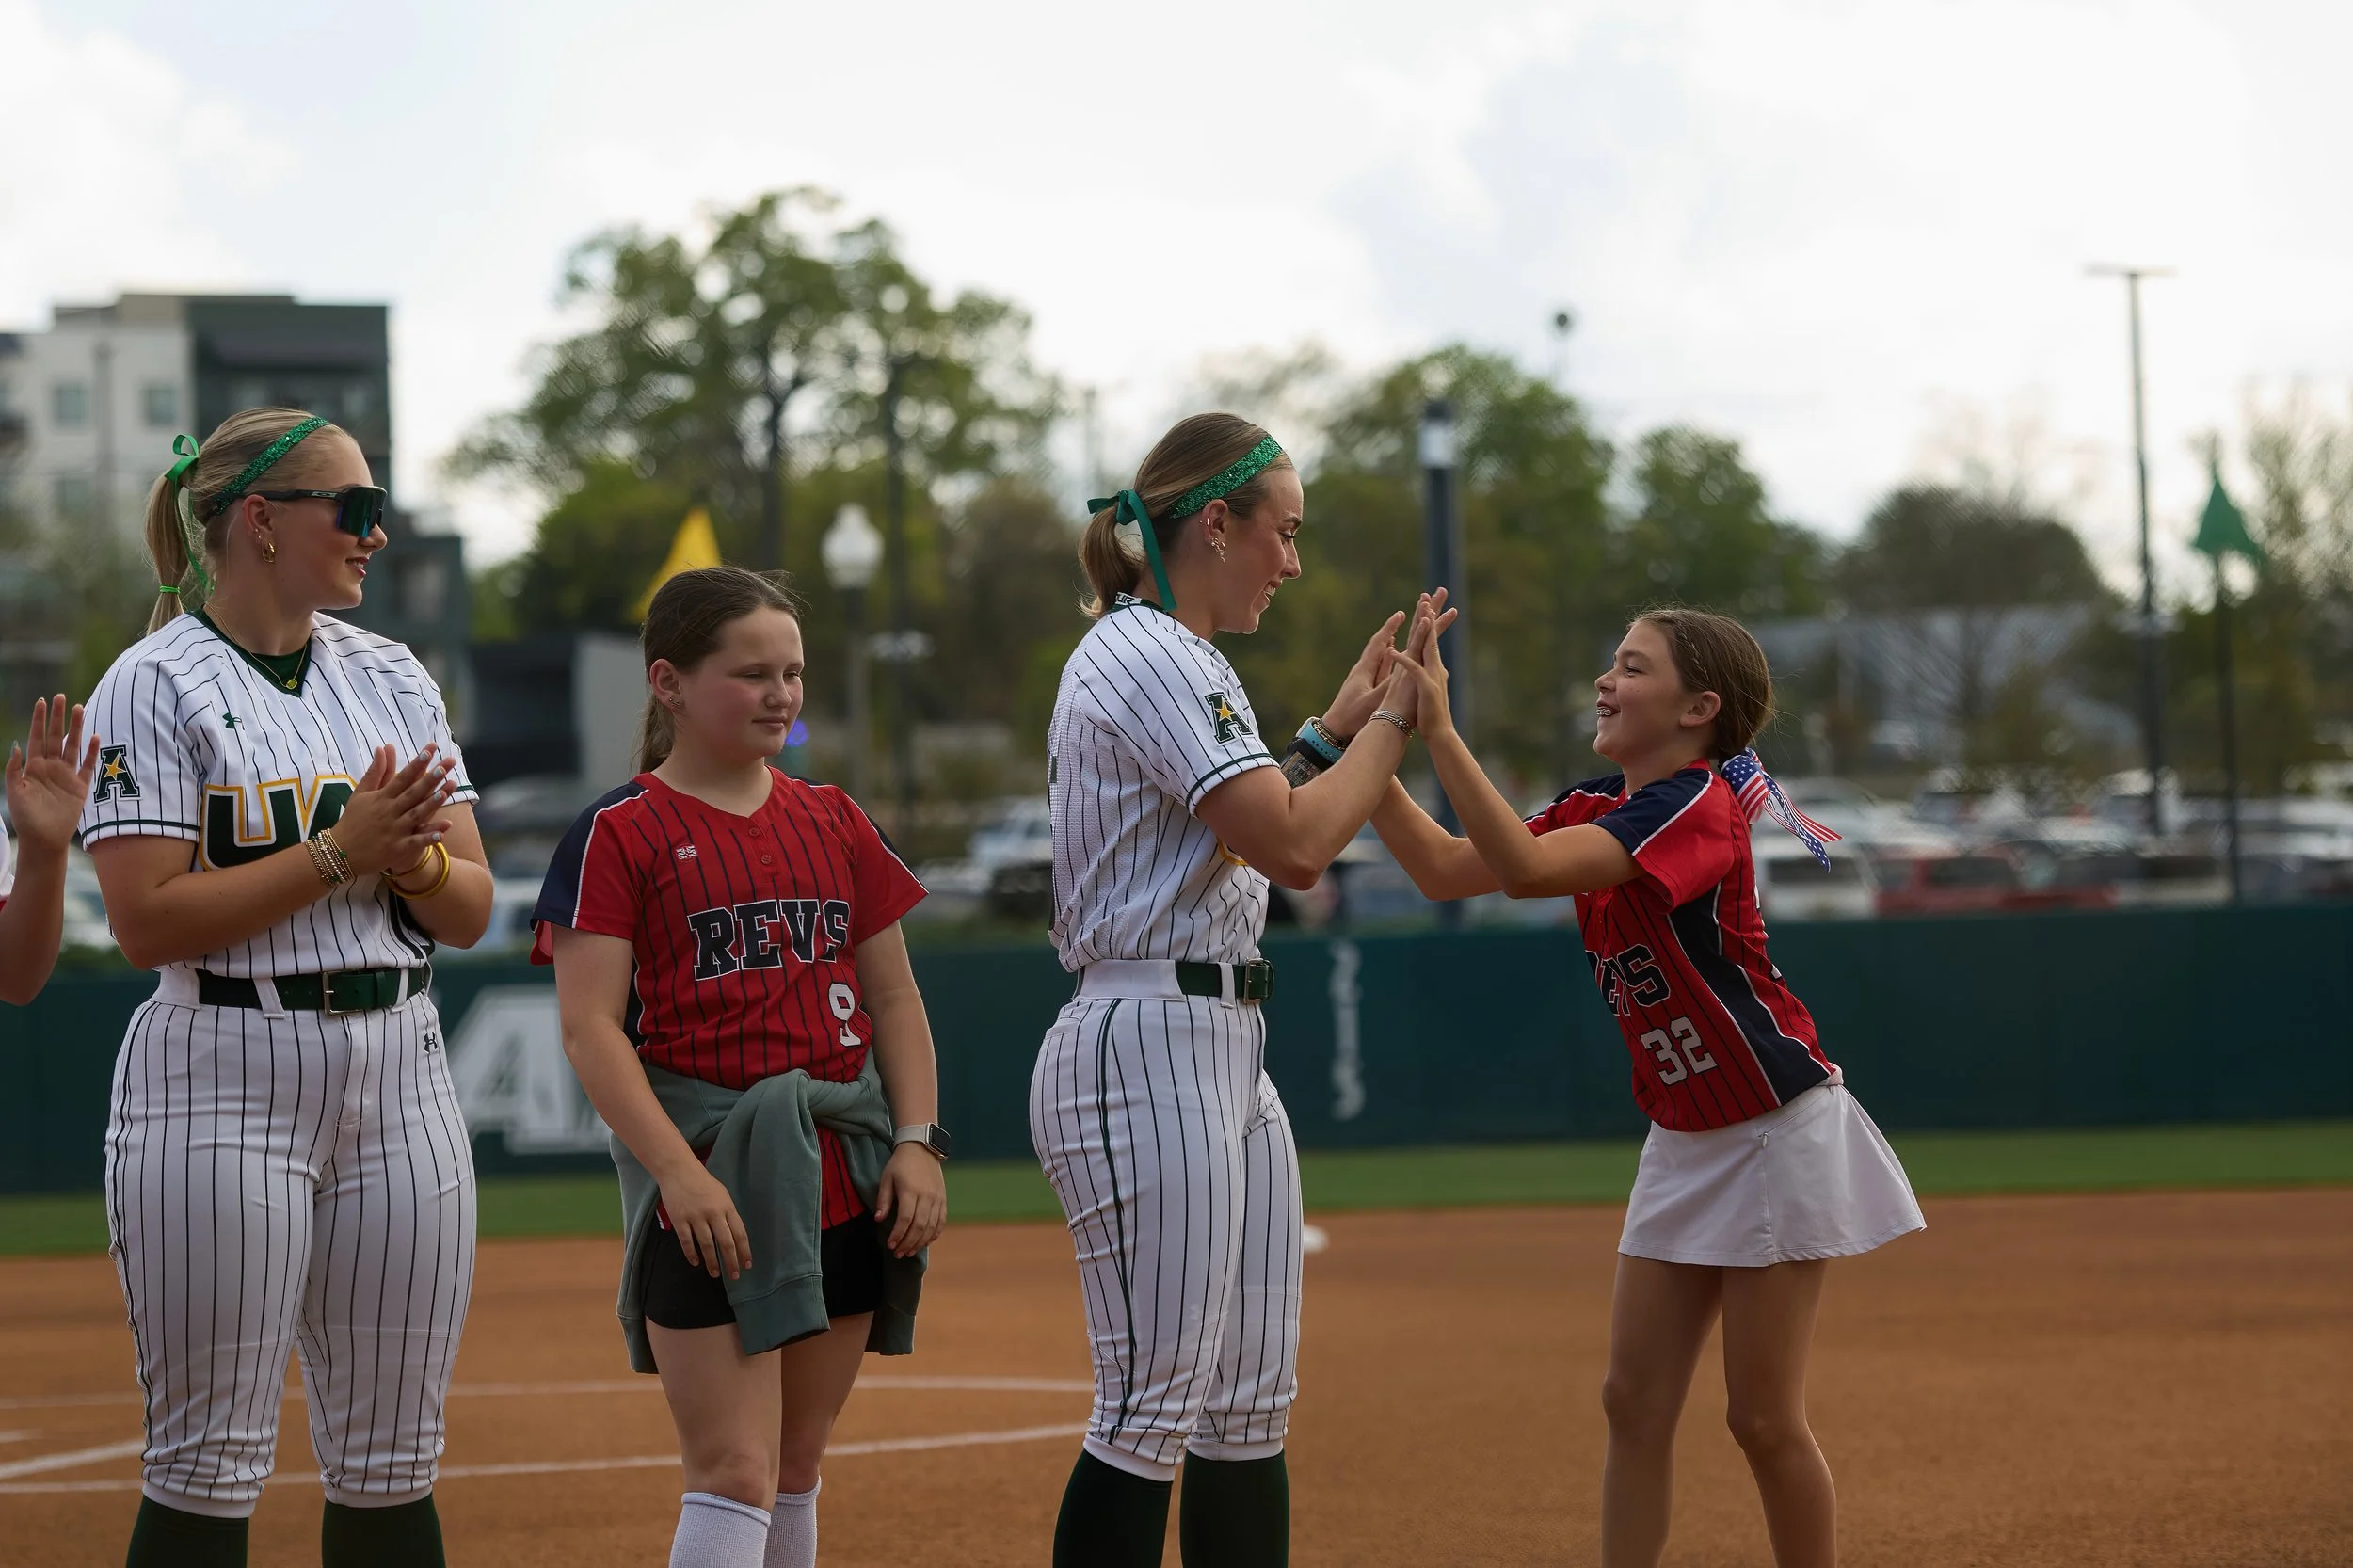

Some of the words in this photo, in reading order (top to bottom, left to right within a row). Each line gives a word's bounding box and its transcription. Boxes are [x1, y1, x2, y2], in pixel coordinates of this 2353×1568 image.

[93, 744, 141, 804] A
[687, 899, 851, 981] REVS
[828, 983, 862, 1047] 9
[1640, 1016, 1718, 1086] 32
